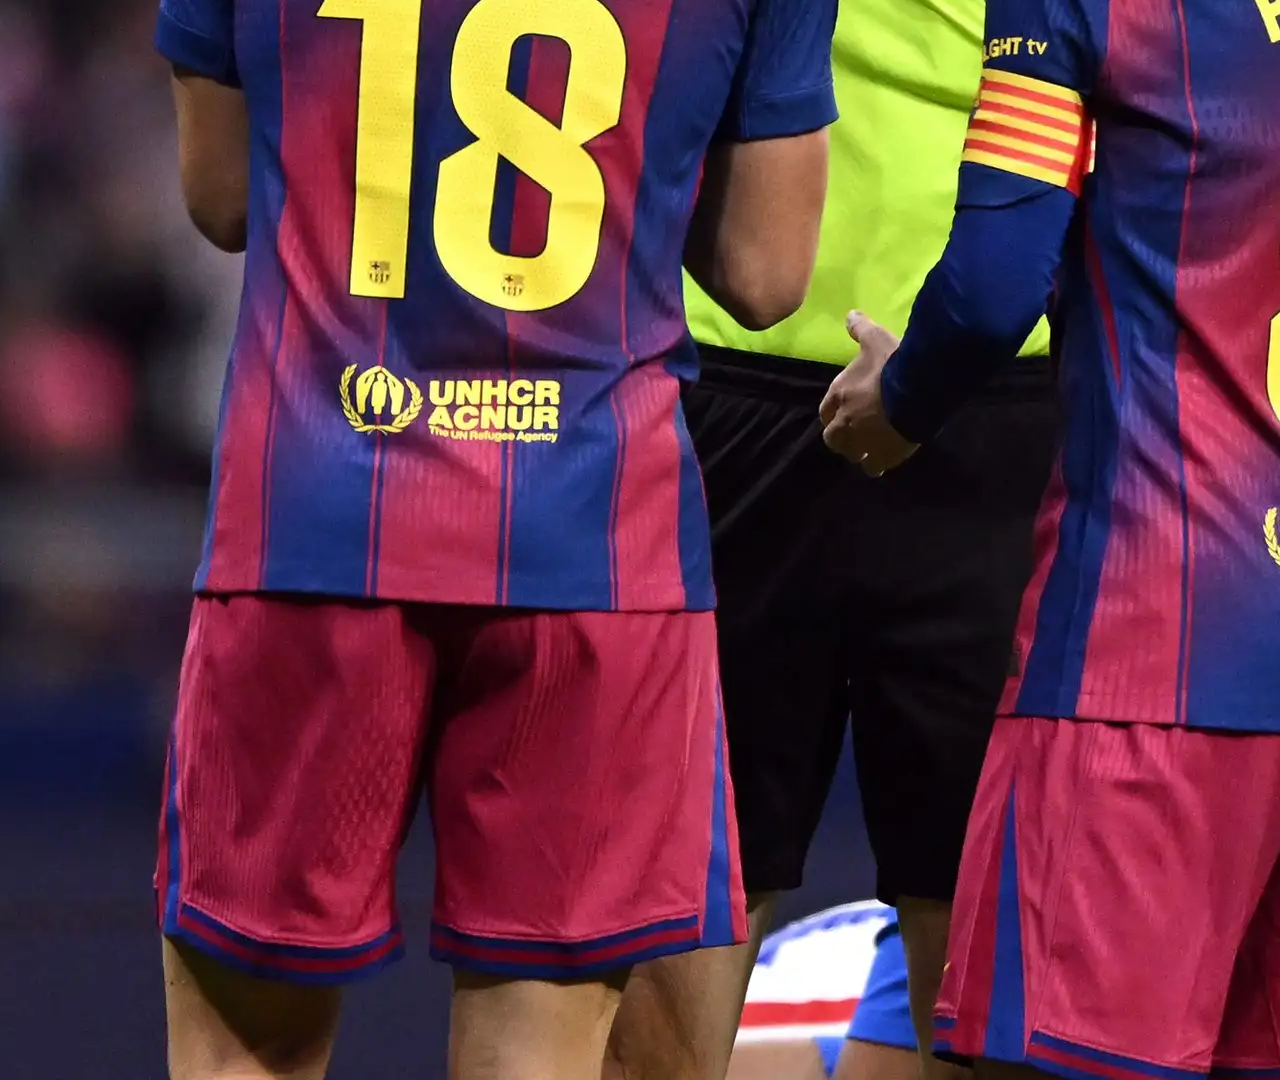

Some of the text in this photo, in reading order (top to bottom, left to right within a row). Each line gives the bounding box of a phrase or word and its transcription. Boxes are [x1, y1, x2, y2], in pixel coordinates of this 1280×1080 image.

[1026, 38, 1048, 55] tv
[429, 380, 560, 405] UNHCR
[427, 406, 559, 430] ACNUR
[429, 425, 449, 438] The
[450, 429, 468, 440] UN
[516, 431, 558, 443] Agency
